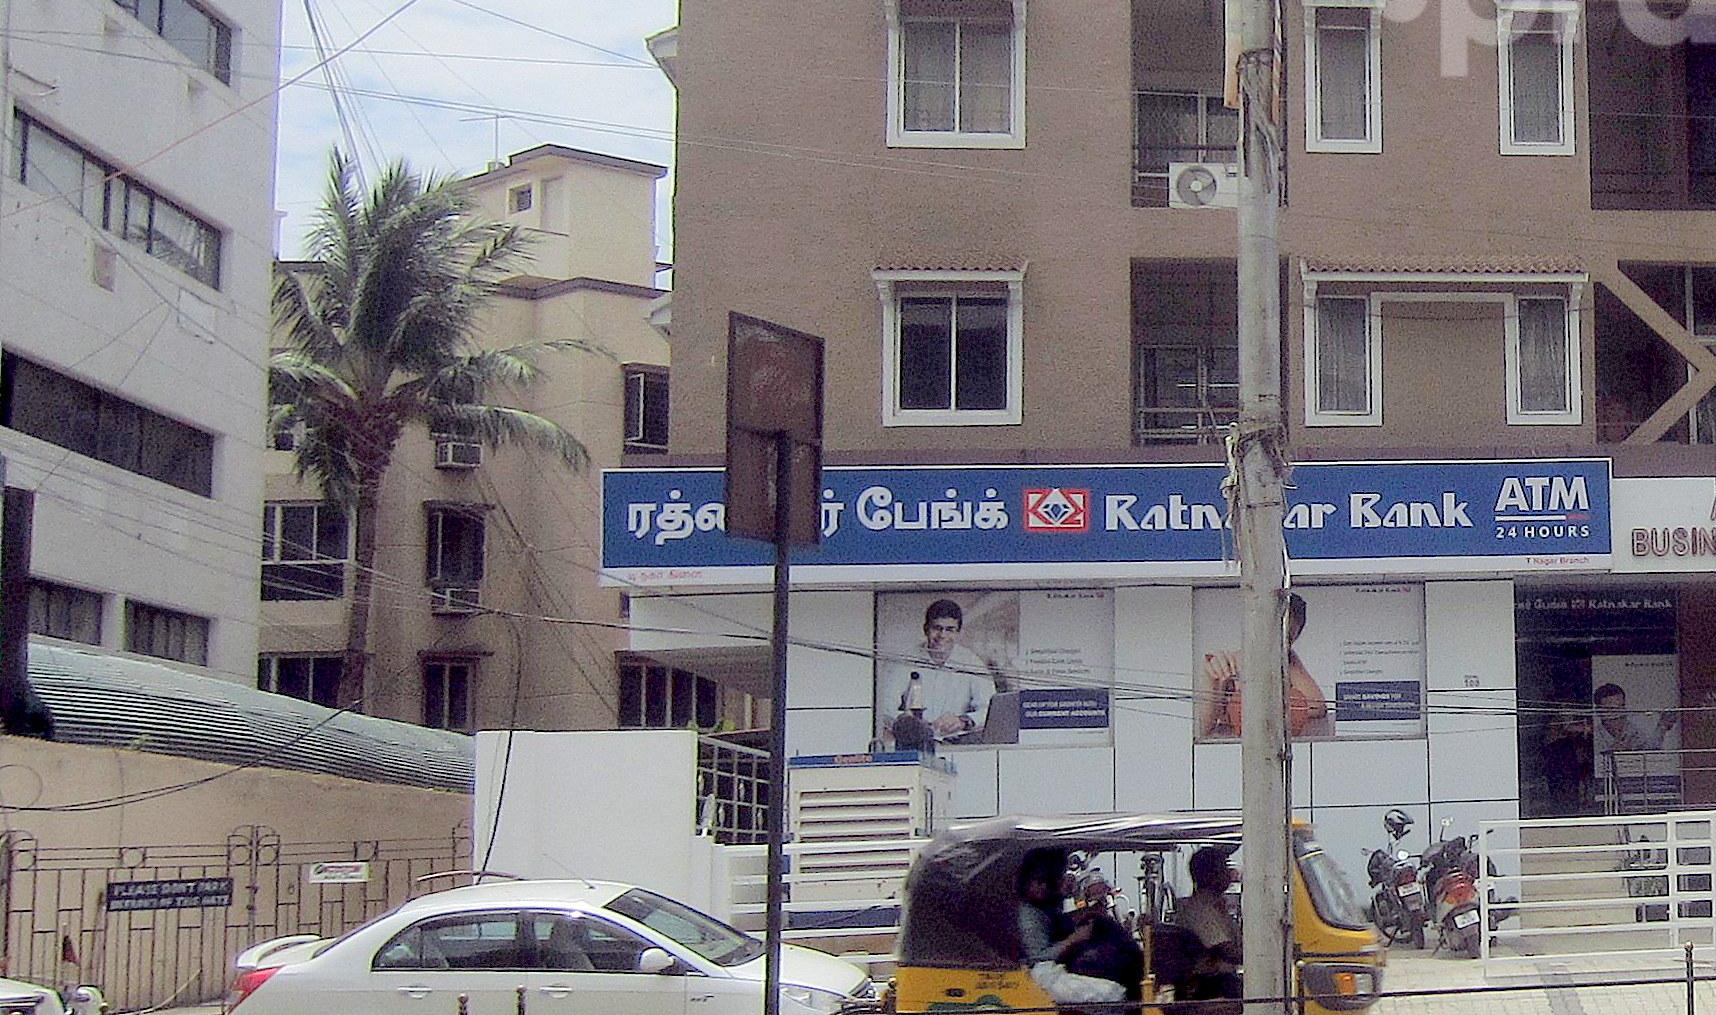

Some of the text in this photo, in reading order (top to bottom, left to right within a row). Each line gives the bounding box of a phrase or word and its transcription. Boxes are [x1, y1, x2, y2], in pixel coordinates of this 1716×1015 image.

[856, 486, 1010, 531] பேங்க்
[1104, 492, 1474, 531] Ratnar Bank
[1494, 475, 1591, 512] ATM
[1495, 524, 1591, 539] 24 HOURS
